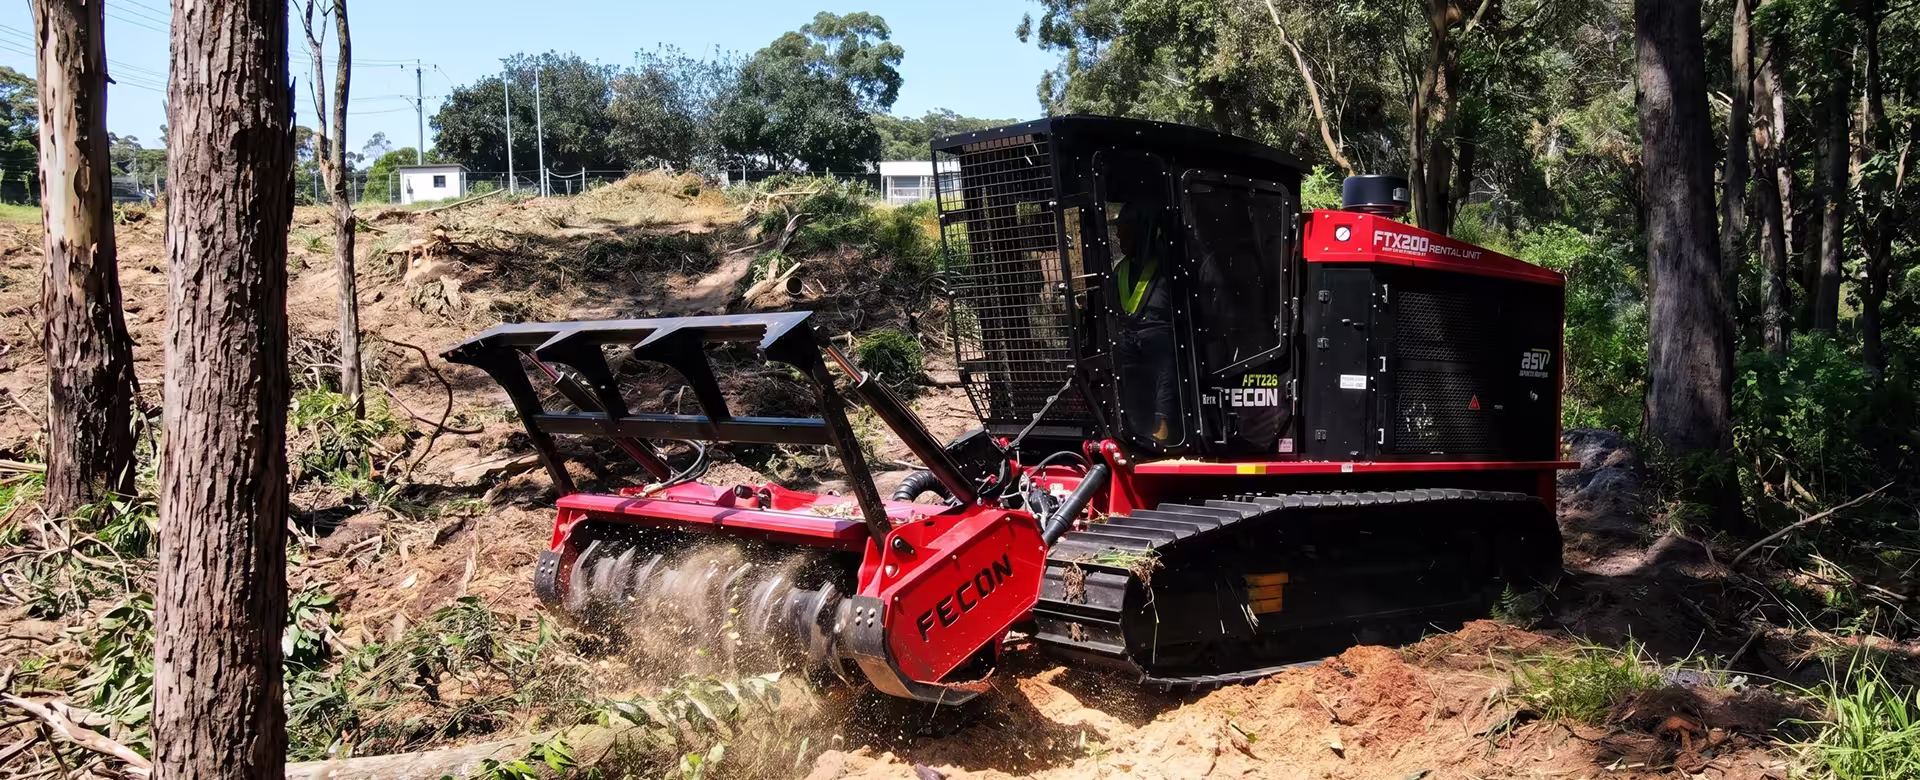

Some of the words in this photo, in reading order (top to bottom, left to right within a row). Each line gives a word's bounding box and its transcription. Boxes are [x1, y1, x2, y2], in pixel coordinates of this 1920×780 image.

[1373, 230, 1429, 252] FTX200
[1429, 244, 1461, 257] RENTAL
[1462, 250, 1482, 260] UNIT
[916, 553, 1014, 643] FECON
